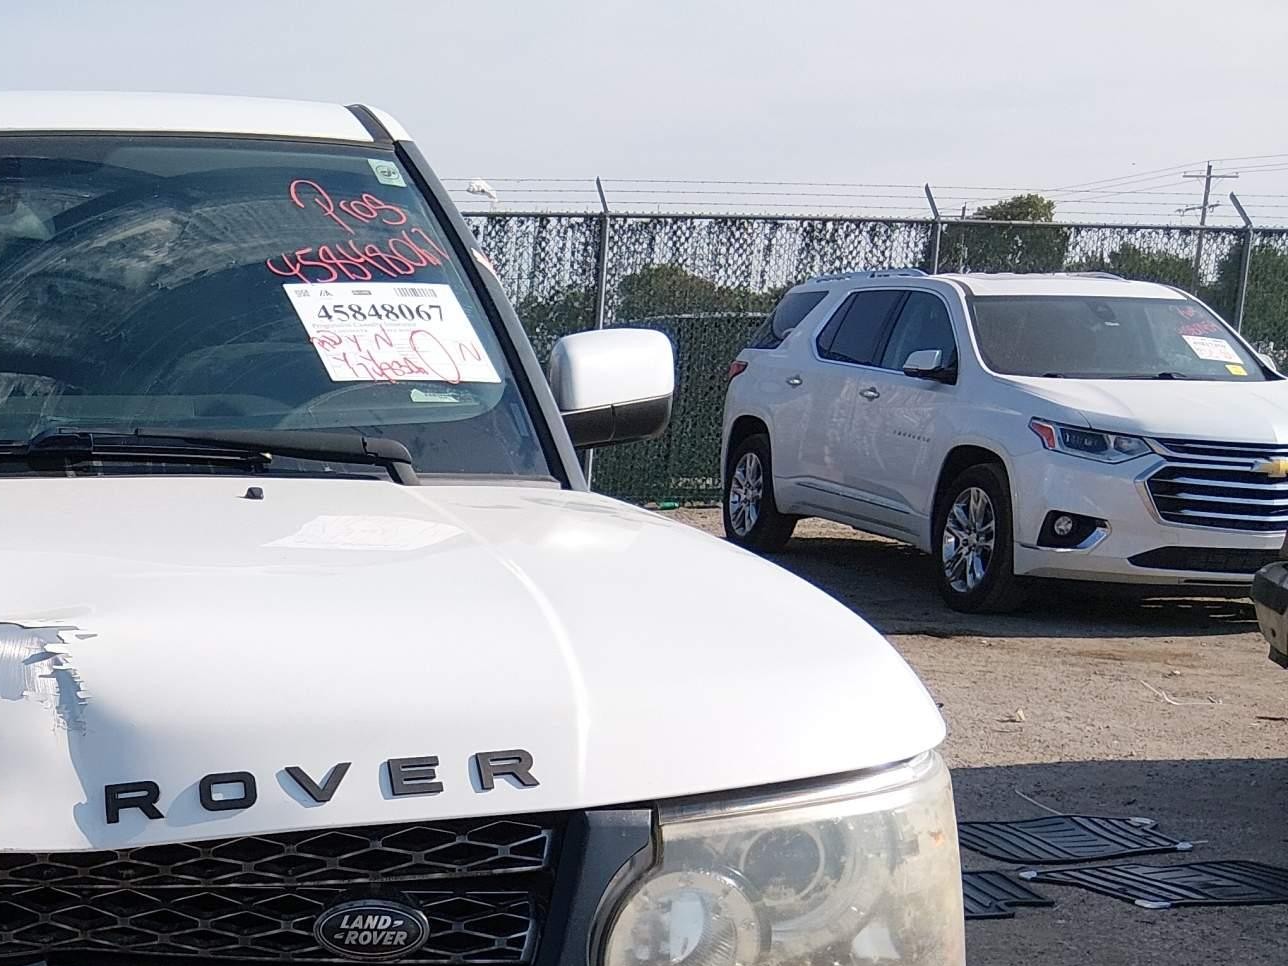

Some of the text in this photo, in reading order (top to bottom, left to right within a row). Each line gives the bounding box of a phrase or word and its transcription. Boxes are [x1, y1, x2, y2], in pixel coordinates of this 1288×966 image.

[317, 303, 444, 322] 45848067
[104, 748, 541, 824] ROVER
[339, 914, 392, 930] LAND
[344, 930, 409, 946] ROVER
